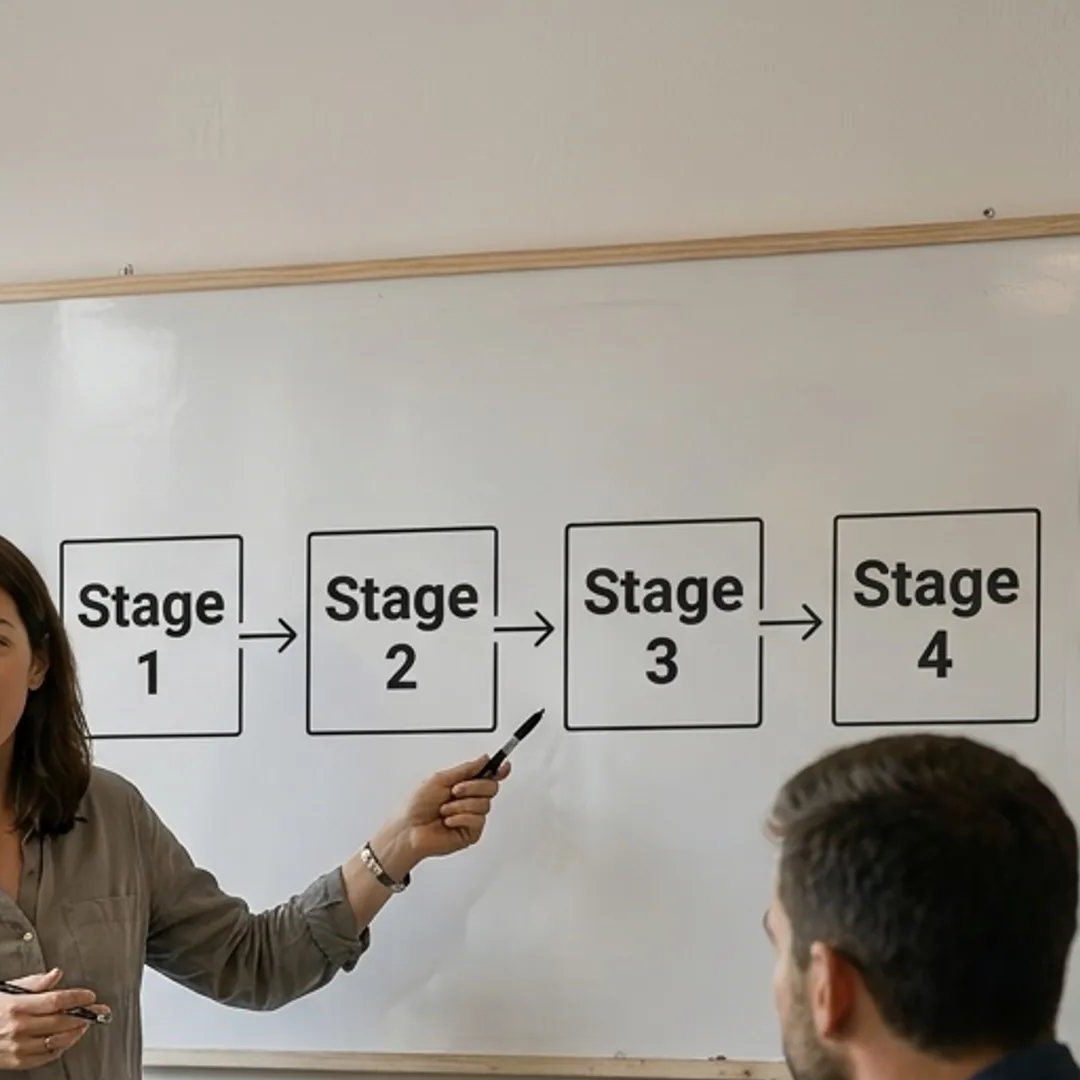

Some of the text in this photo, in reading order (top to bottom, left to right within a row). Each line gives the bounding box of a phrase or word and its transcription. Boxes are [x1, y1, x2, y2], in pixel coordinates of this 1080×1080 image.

[78, 583, 225, 638] Stage
[325, 575, 479, 632] Stage
[584, 567, 744, 626] Stage
[853, 559, 1020, 618] Stage
[138, 650, 157, 695] 1
[385, 643, 417, 690] 2
[645, 636, 678, 685] 3
[917, 629, 953, 679] 4
